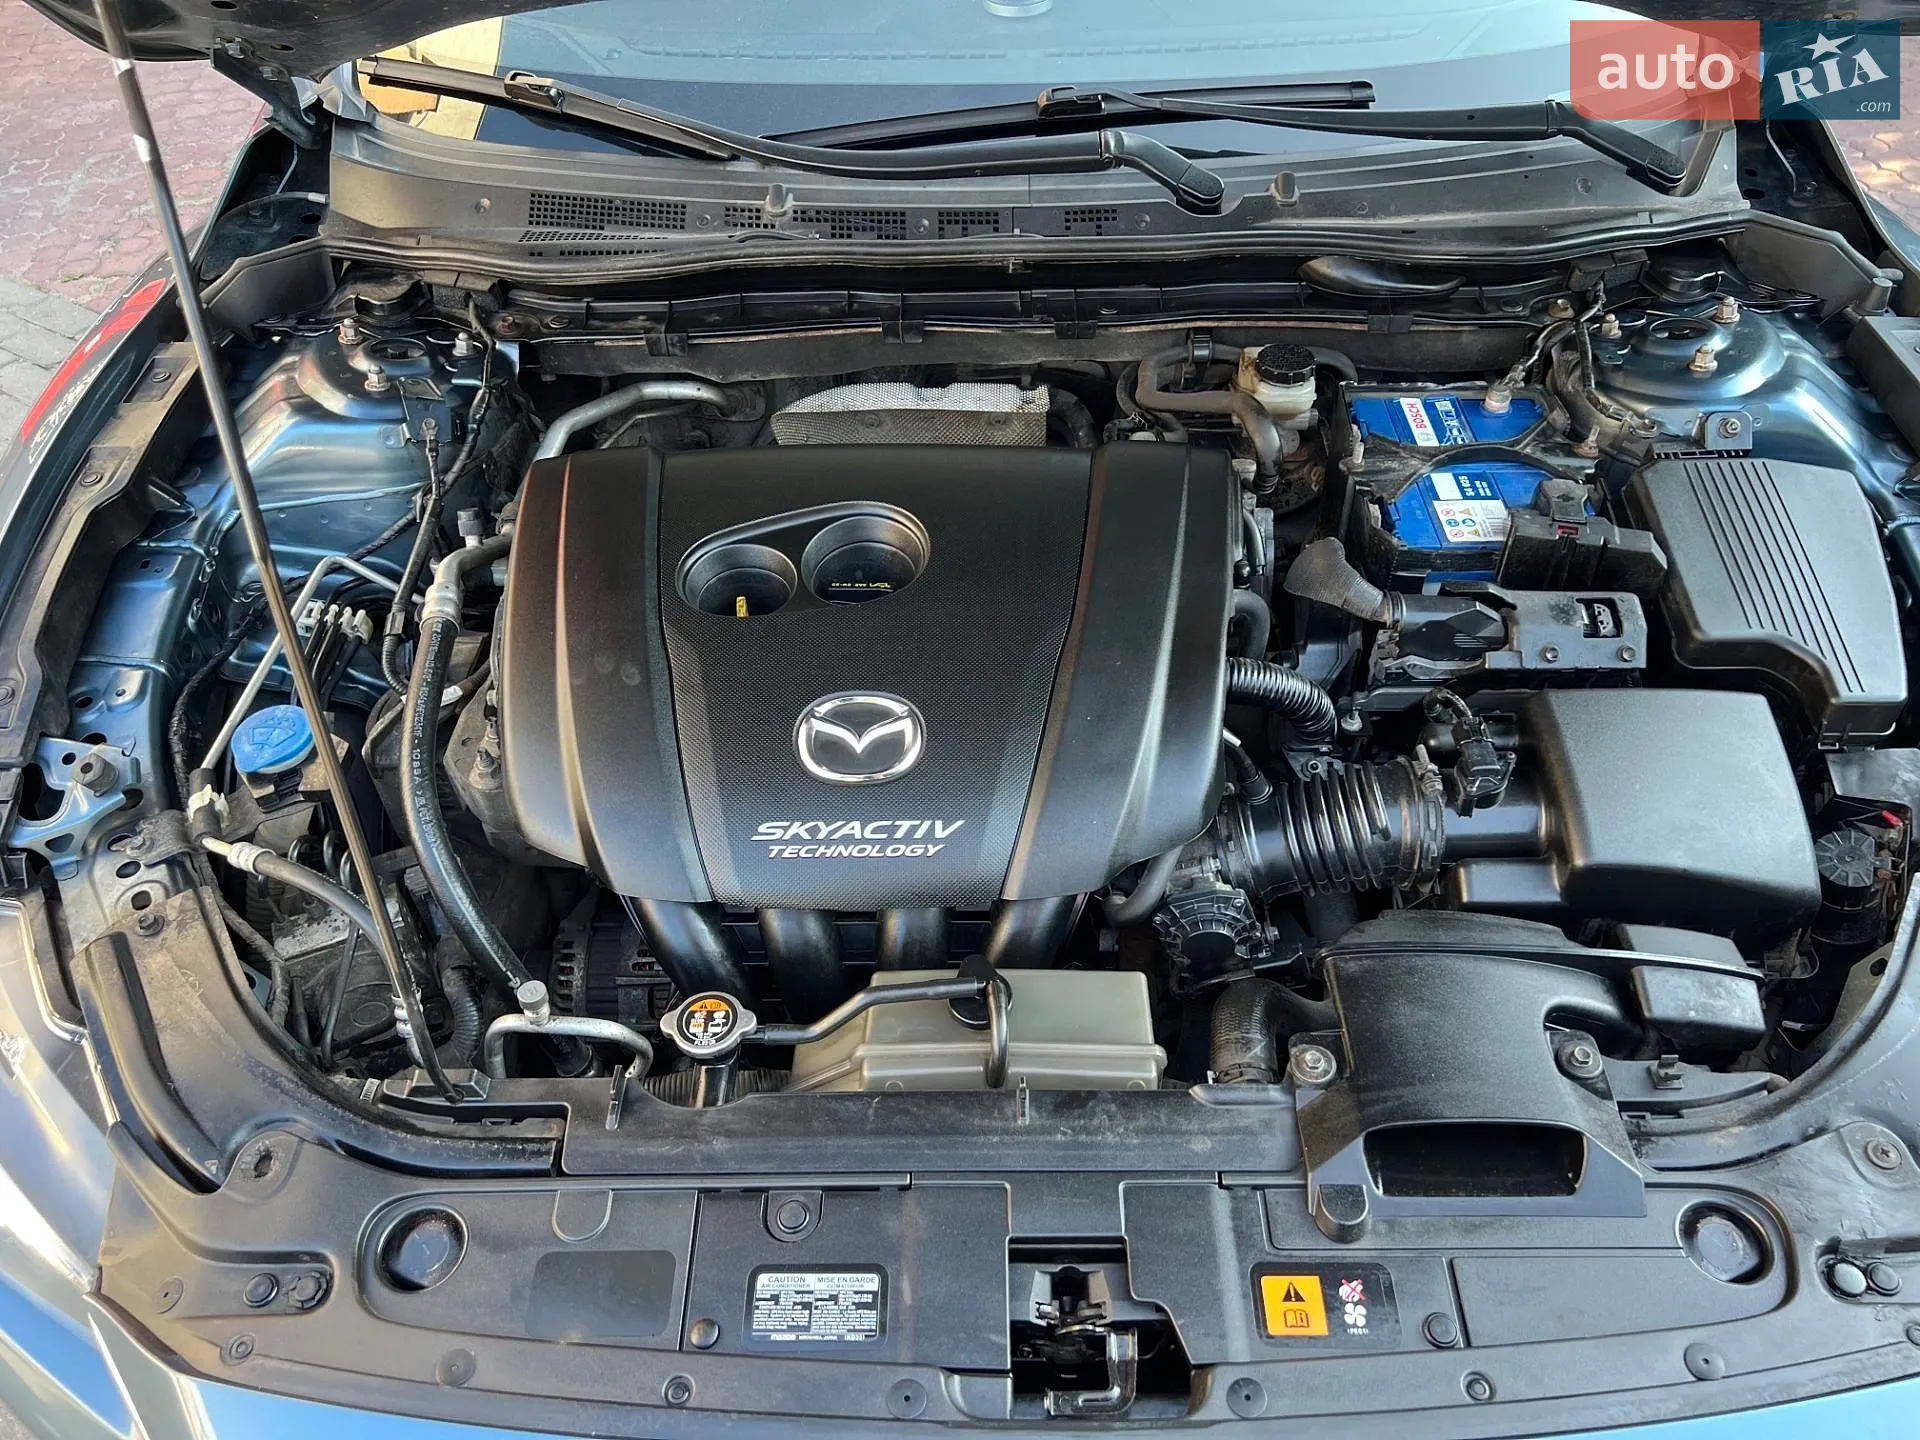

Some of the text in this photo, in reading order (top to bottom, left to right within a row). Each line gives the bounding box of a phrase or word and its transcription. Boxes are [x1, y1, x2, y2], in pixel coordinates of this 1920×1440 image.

[1406, 403, 1427, 429] BOSCH
[751, 820, 965, 841] SKYACTIV
[769, 844, 946, 858] TECHNOLOGY
